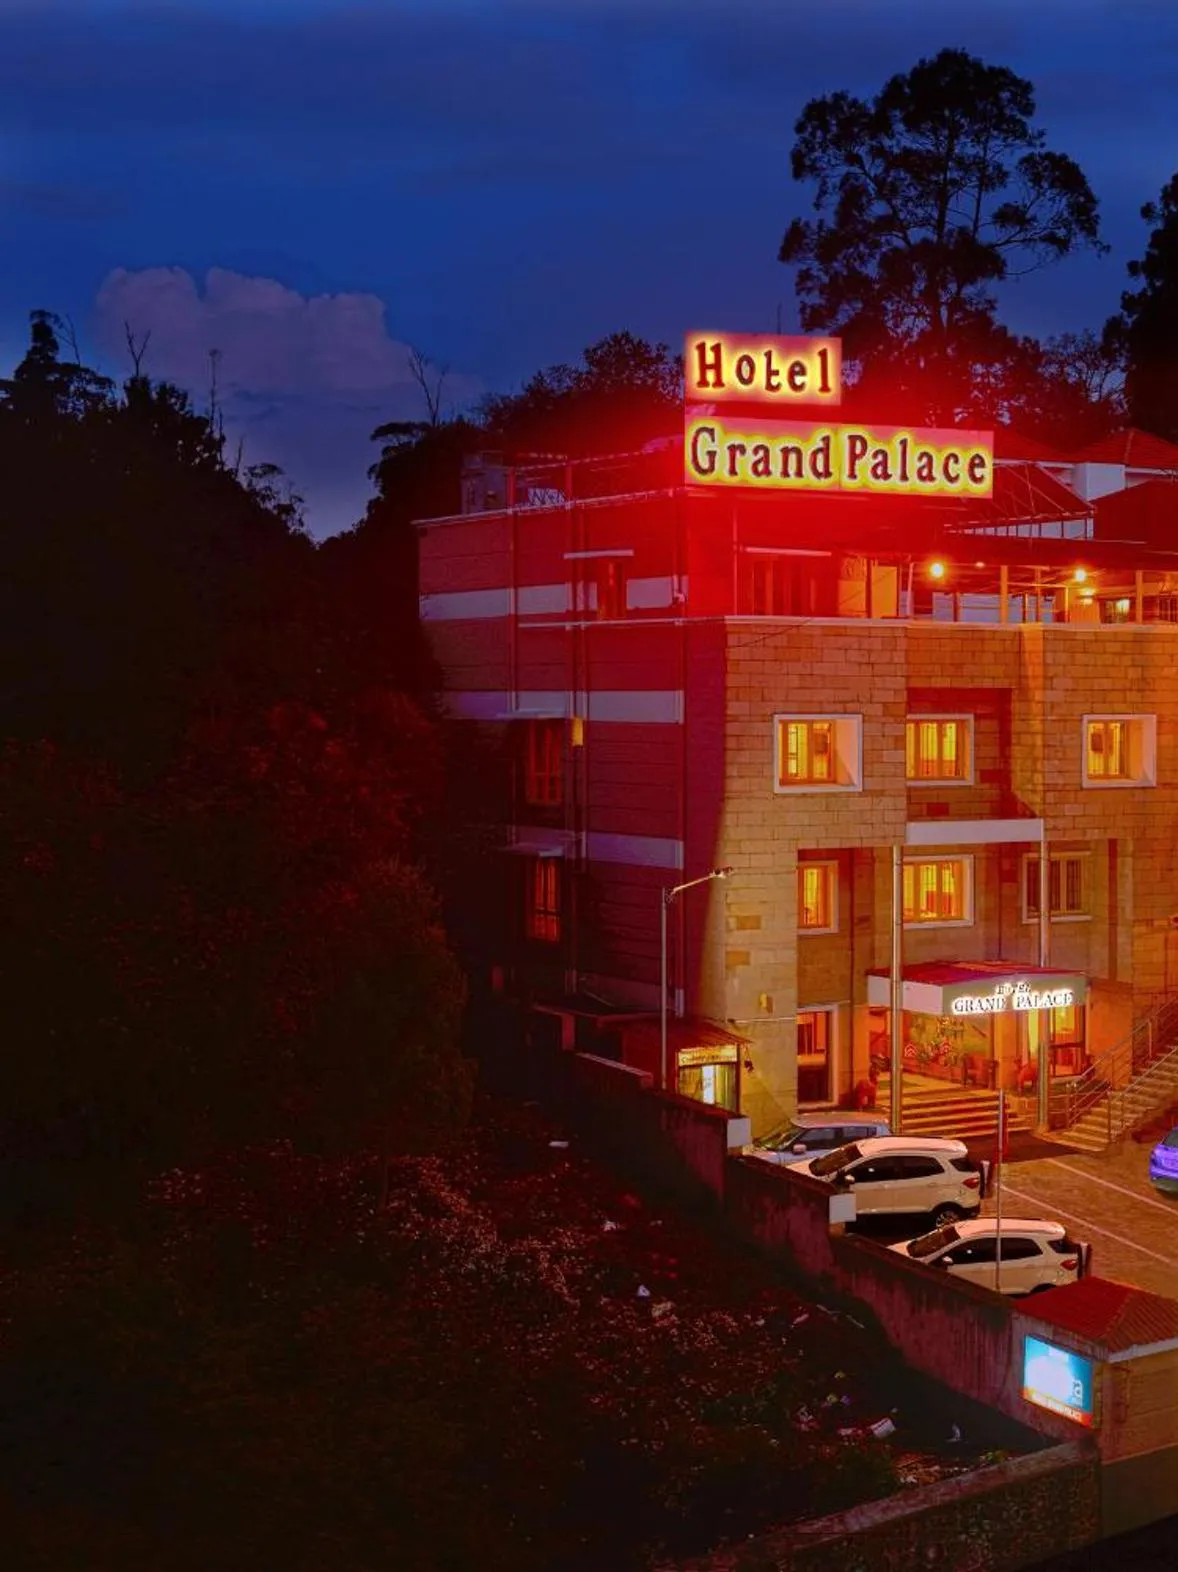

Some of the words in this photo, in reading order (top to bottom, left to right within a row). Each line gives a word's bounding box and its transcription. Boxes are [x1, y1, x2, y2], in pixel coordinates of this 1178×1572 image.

[694, 340, 832, 393] Hotel
[690, 426, 833, 480] Grand
[846, 433, 987, 485] Palace
[953, 996, 1006, 1013] GRAND
